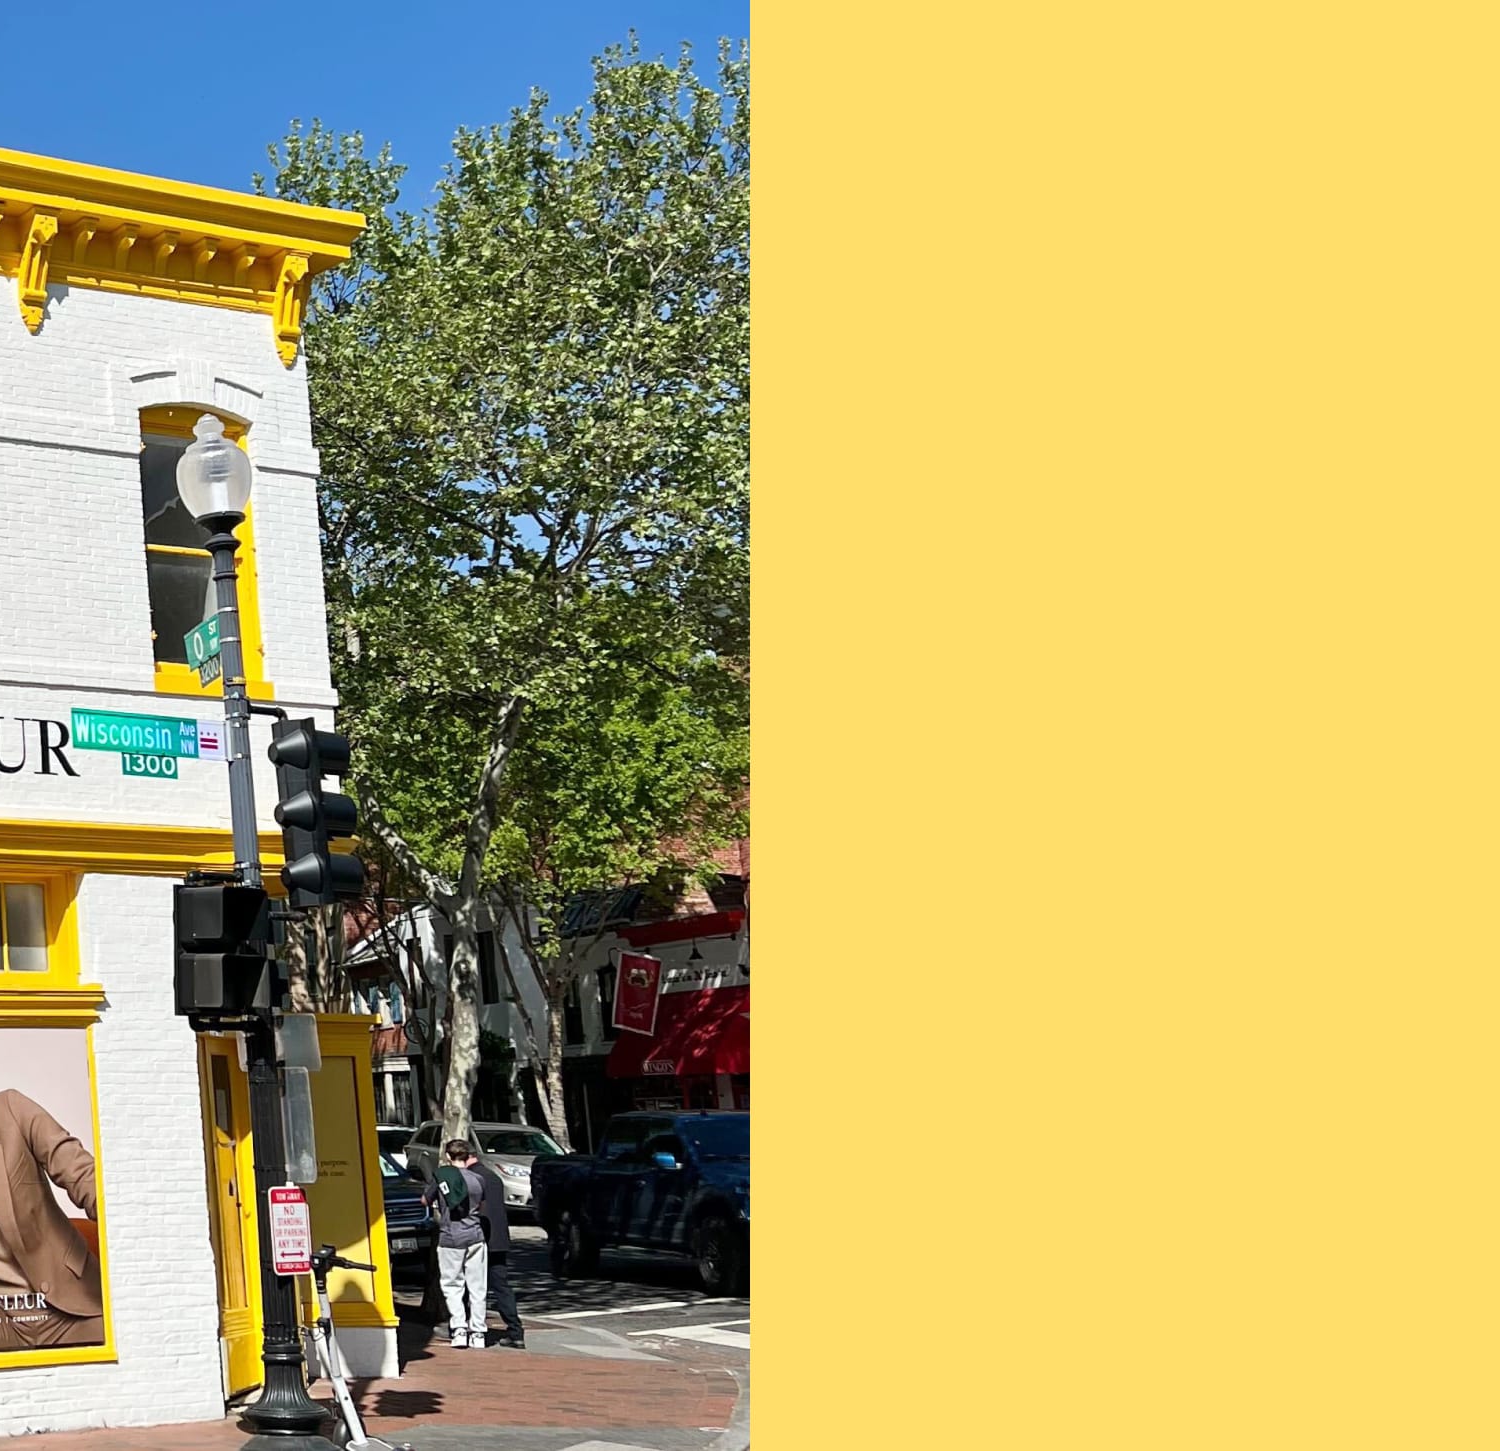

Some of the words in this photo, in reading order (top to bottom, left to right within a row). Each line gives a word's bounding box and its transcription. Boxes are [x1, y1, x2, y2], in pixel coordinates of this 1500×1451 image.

[193, 632, 204, 660] O
[208, 620, 217, 635] ST
[73, 714, 172, 750] Wisconsin
[179, 721, 196, 737] Ave
[180, 740, 196, 754] NW
[123, 753, 176, 775] 1300
[283, 1205, 295, 1216] NO
[278, 1240, 289, 1248] ANY
[292, 1239, 306, 1248] TIME
